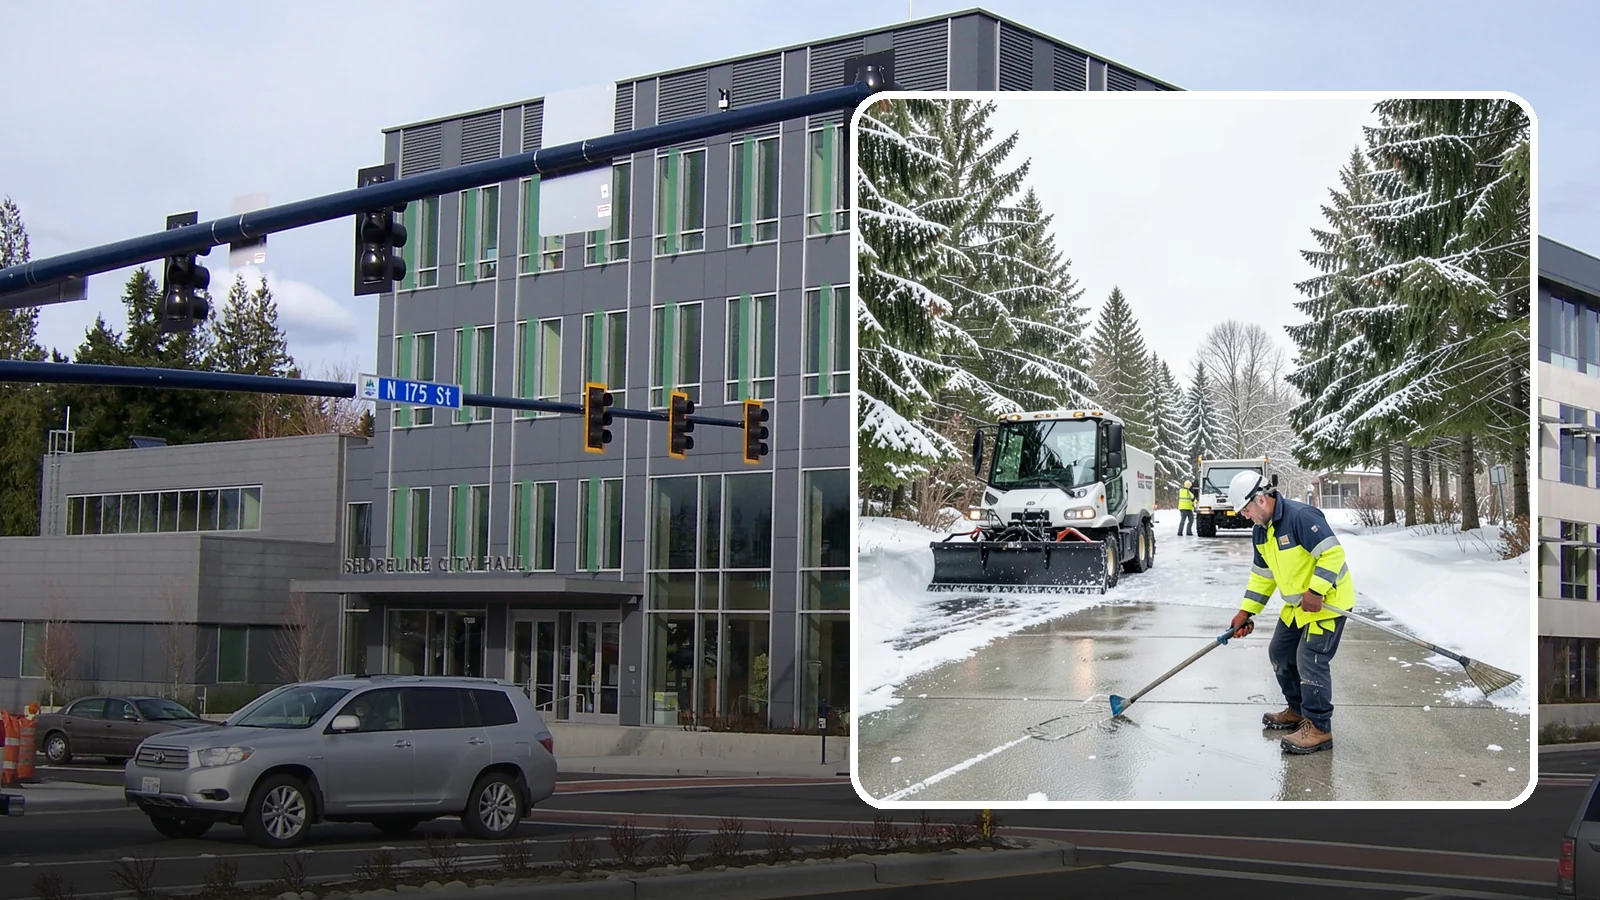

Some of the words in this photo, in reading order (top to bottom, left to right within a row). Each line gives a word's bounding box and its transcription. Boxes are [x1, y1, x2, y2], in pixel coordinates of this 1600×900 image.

[387, 380, 396, 400] N
[405, 382, 427, 403] 175
[436, 386, 451, 406] St
[343, 557, 431, 573] SHORELINE
[439, 556, 476, 572] CITY
[484, 556, 525, 572] HALL
